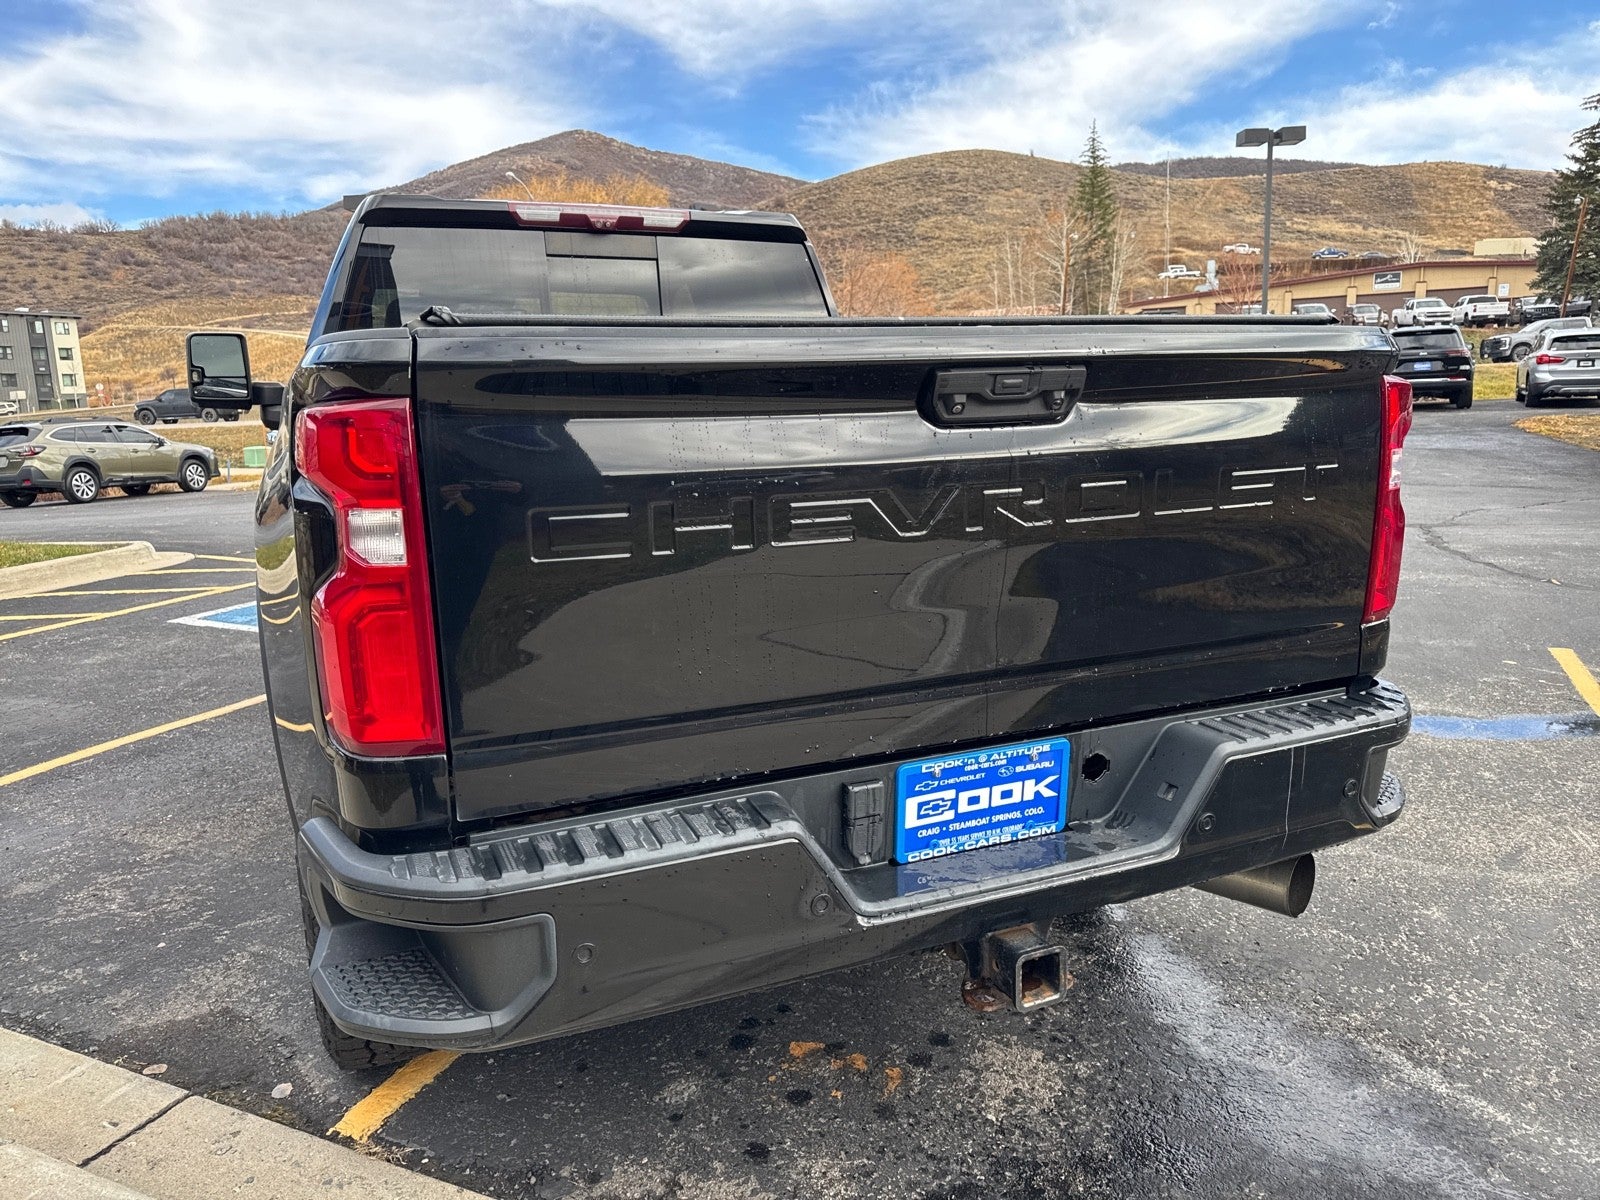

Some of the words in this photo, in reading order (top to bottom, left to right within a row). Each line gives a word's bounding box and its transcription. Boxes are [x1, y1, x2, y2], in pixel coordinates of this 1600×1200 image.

[527, 463, 1338, 564] CHEVROLET
[990, 744, 1051, 761] ALTITUDE
[1015, 760, 1055, 773] SUBARU
[940, 772, 986, 786] CHEVROLET
[905, 774, 1060, 829] COOK
[917, 826, 941, 838] CRAIG
[948, 816, 991, 832] STEAMBOAT
[1024, 806, 1046, 816] COLO.
[907, 825, 1057, 863] COOK-CARS.COM
